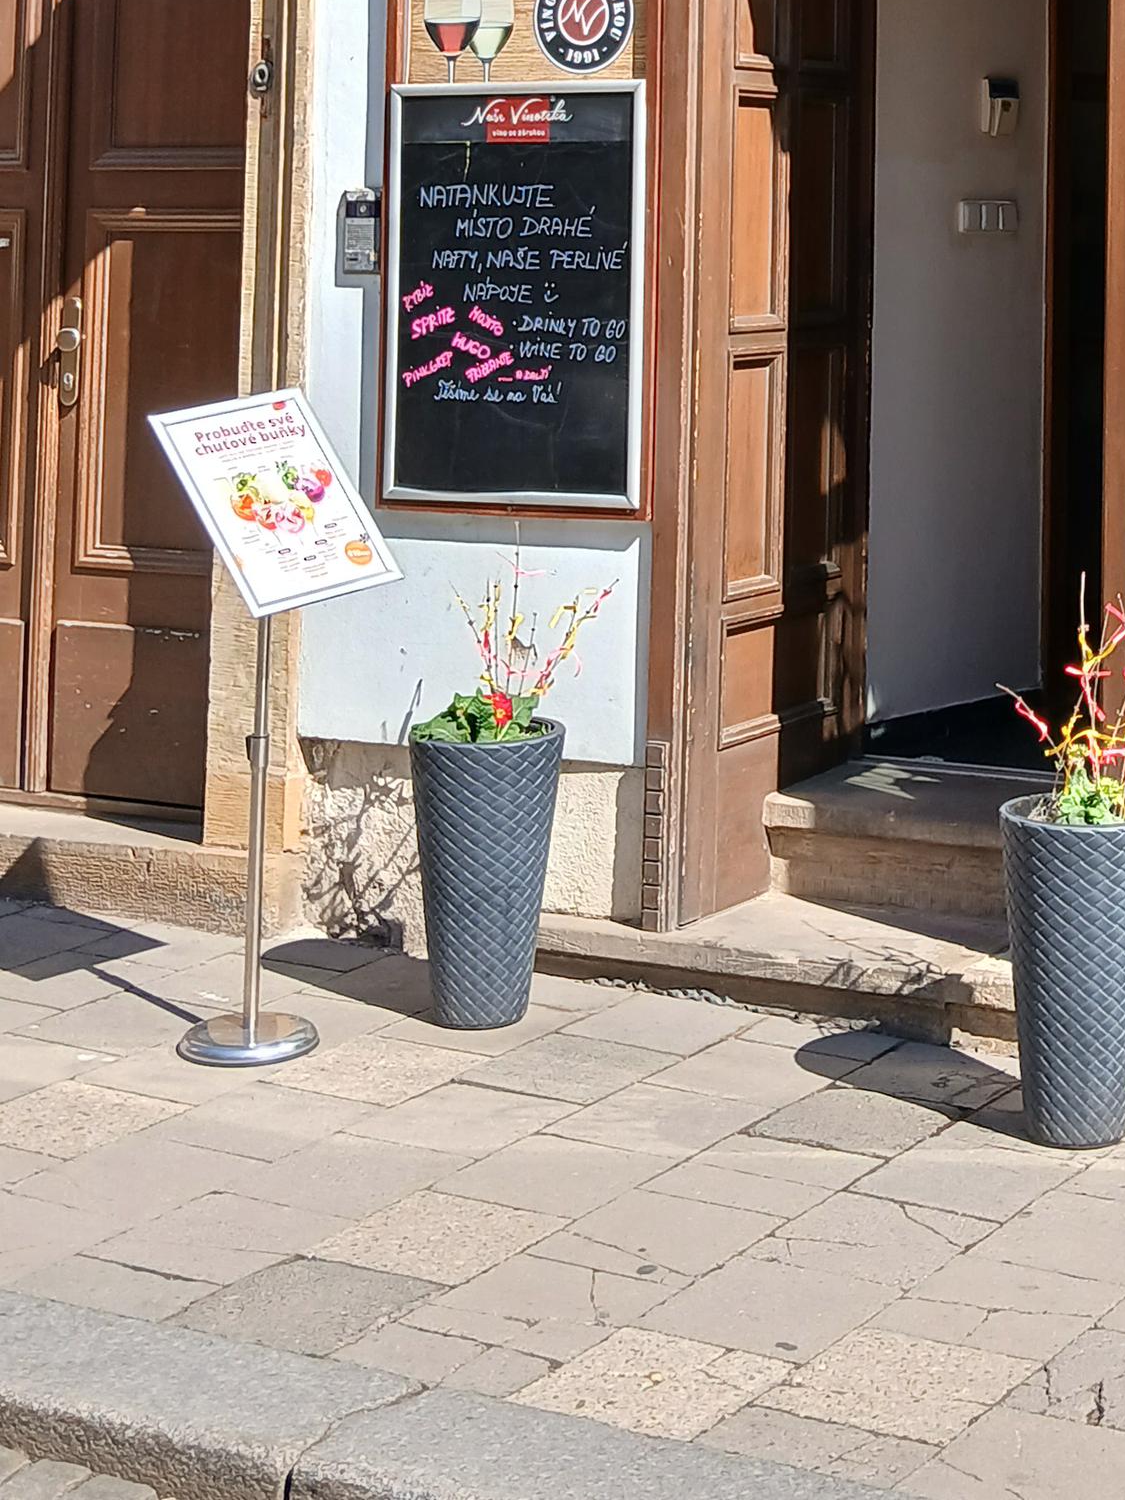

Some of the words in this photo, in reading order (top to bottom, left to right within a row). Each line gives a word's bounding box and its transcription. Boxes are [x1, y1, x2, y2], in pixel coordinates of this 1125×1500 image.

[565, 48, 601, 64] 1991
[420, 184, 556, 208] NATANKUJTE
[456, 209, 514, 239] MÍSTO
[520, 206, 596, 238] DRAHÉ
[486, 247, 541, 271] NAŠE
[550, 241, 628, 271] PERLIVÉ
[463, 277, 533, 303] NÁPOJE
[582, 317, 601, 337] TO
[605, 319, 626, 339] GO
[451, 331, 491, 359] HUGO
[519, 338, 562, 359] WINE
[569, 343, 587, 361] TO
[594, 345, 617, 363] GO
[483, 386, 503, 401] se
[506, 391, 527, 402] na
[194, 420, 266, 443] Probuďte
[268, 411, 295, 427] své
